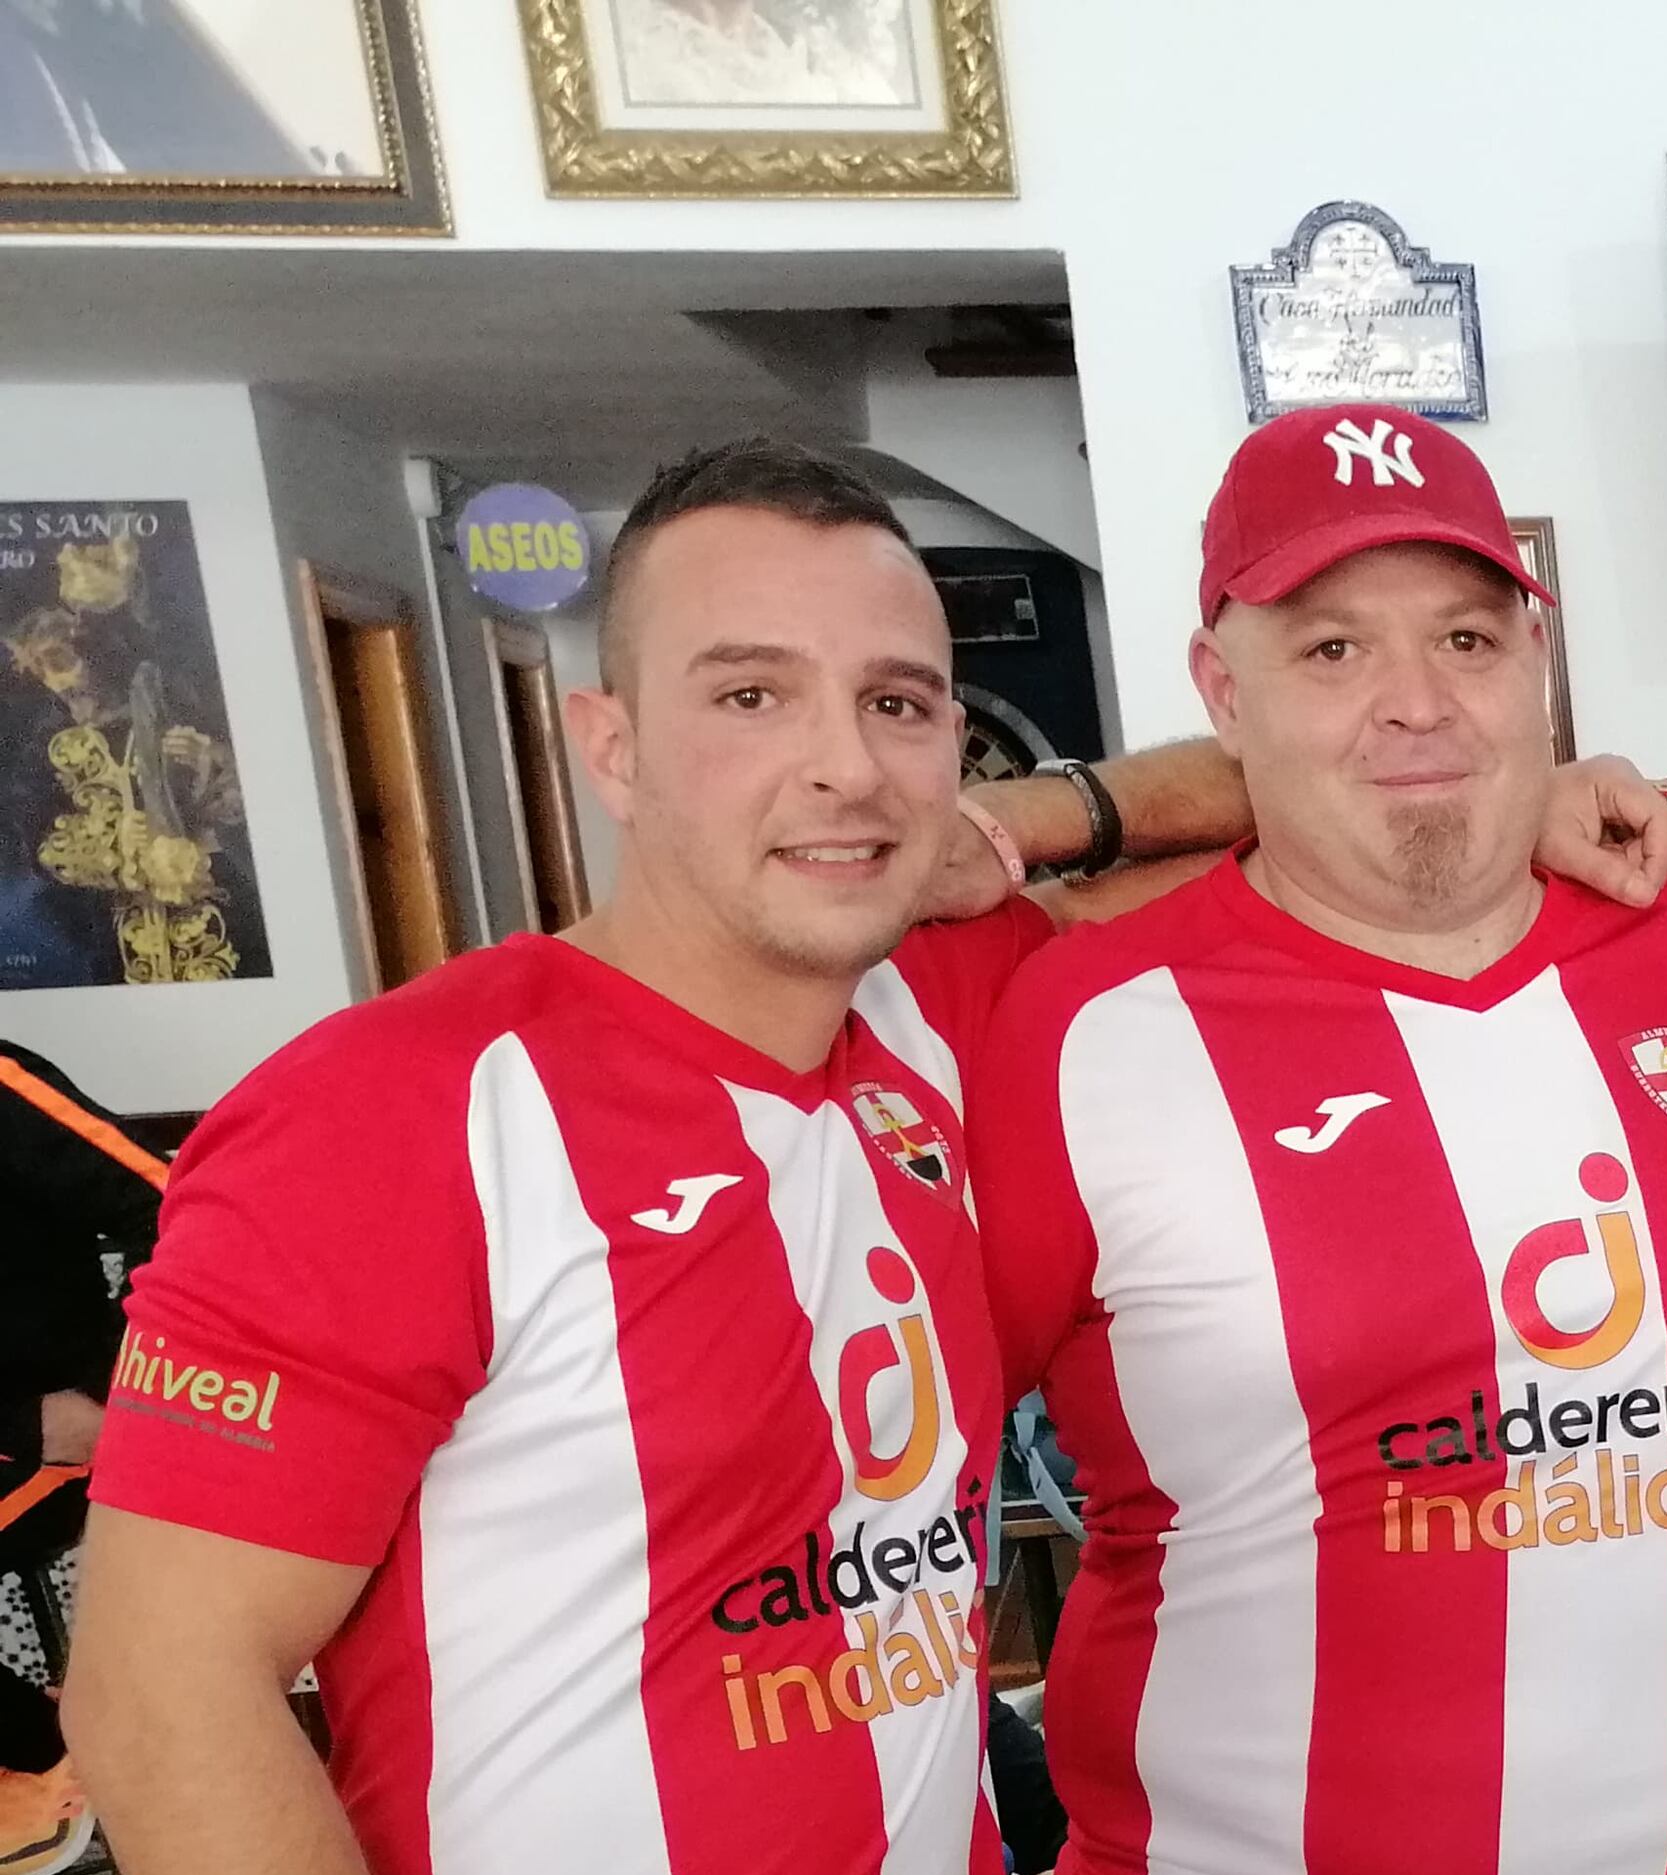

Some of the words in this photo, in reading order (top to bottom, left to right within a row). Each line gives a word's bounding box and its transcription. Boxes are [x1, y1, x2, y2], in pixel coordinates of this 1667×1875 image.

[1323, 418, 1426, 488] NY
[36, 512, 159, 539] SANTO
[468, 521, 584, 573] ASEOS
